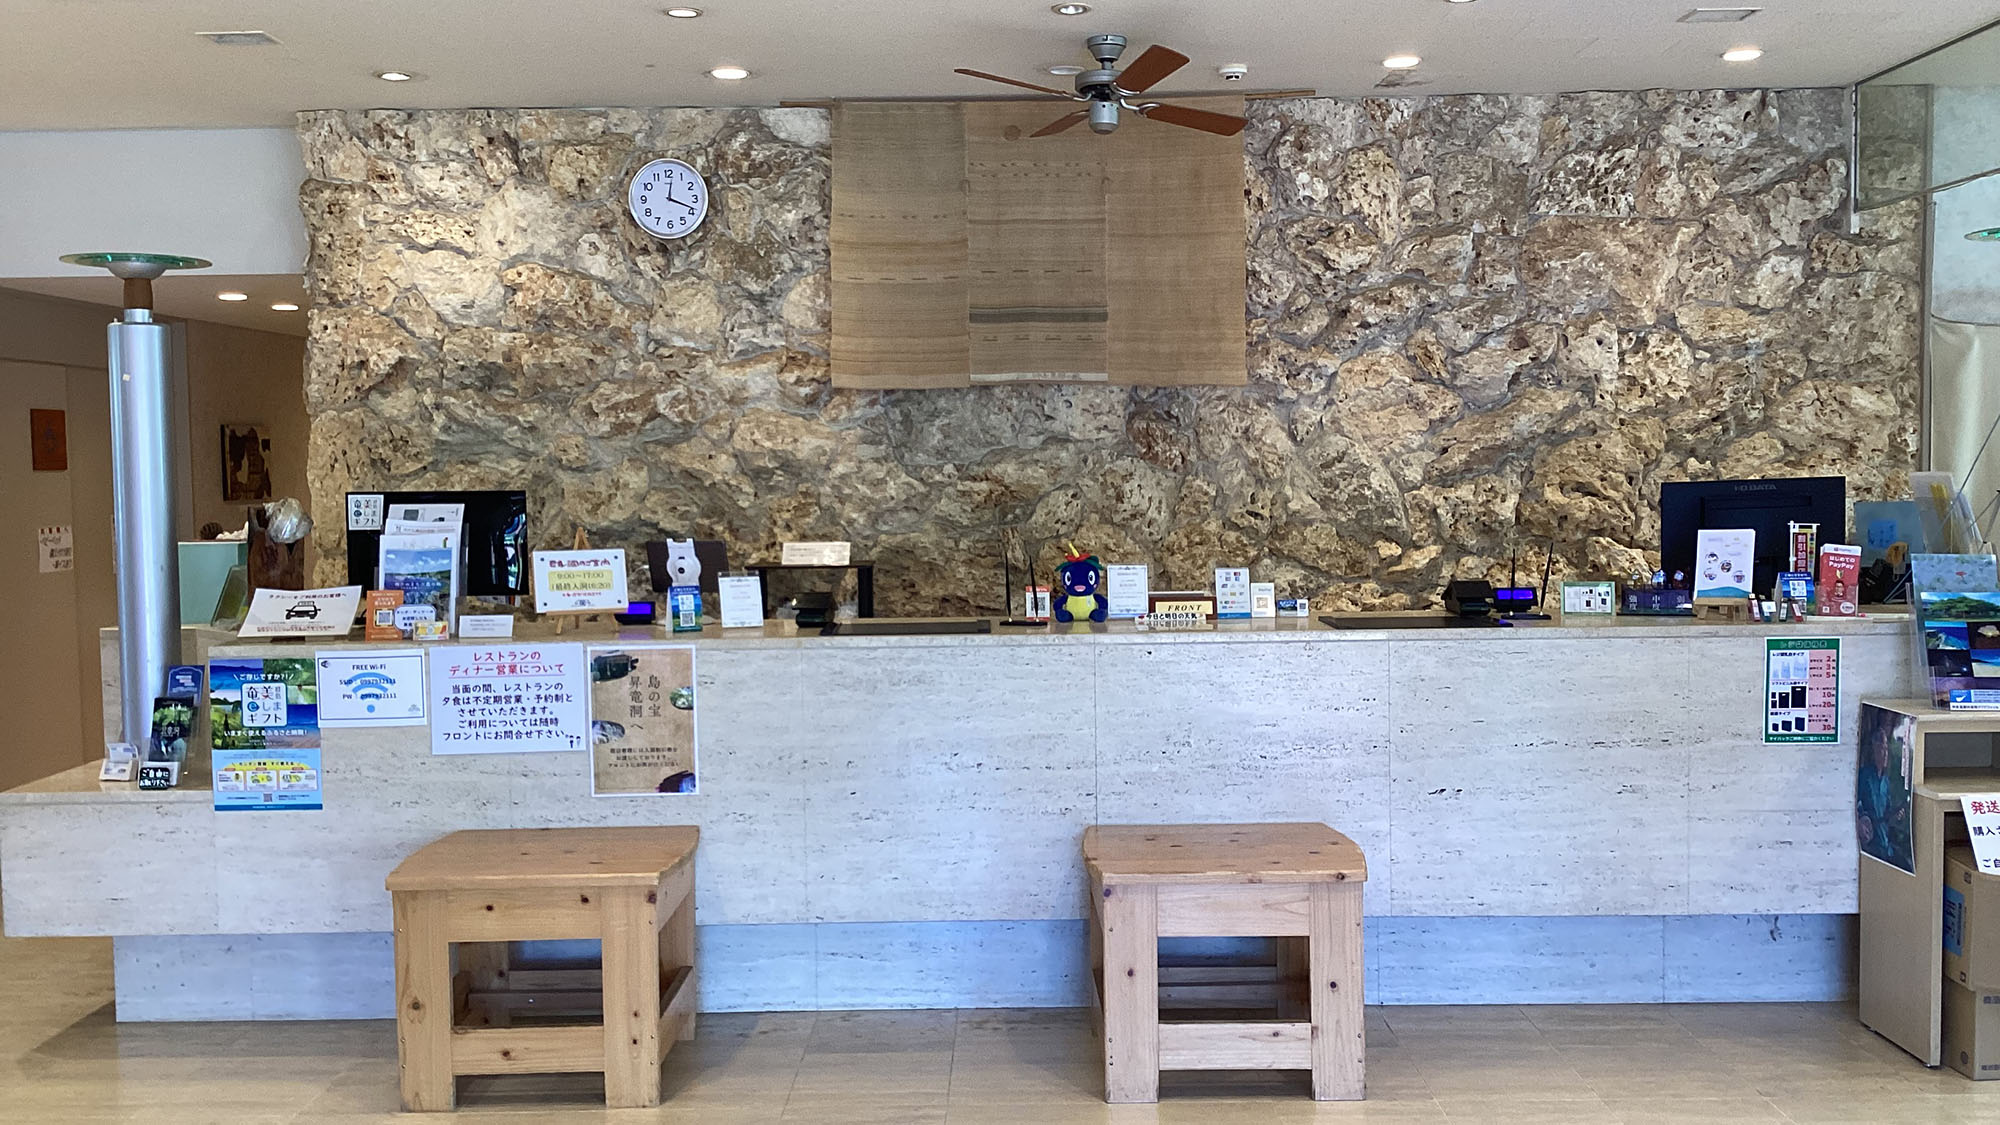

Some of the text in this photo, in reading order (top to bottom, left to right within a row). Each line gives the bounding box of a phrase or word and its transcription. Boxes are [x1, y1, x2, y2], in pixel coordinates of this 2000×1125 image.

[653, 173, 660, 182] 11
[664, 169, 673, 178] 12
[680, 173, 683, 181] 1
[643, 182, 653, 191] 10
[688, 182, 694, 190] 2
[640, 195, 647, 204] 9
[692, 195, 698, 203] 3
[645, 208, 652, 217] 8
[688, 207, 695, 216] 4
[654, 217, 661, 225] 7
[667, 220, 674, 229] 6
[680, 217, 686, 225] 5
[1828, 561, 1855, 570] PayPay
[1167, 604, 1203, 612] FRONT
[1146, 612, 1198, 620] 今日と明日の天気
[473, 651, 541, 662] レストランの
[449, 663, 565, 676] ディナー営業について
[452, 682, 564, 694] 当面の間、レストランの
[442, 693, 573, 706] 夕食は不定期営業・予約制と
[647, 674, 661, 718] 島の宝
[629, 675, 643, 730] 昇竜洞へ
[458, 706, 554, 717] させていただきます。
[247, 713, 282, 724] ギフト
[458, 717, 559, 729] ご利用については随時
[442, 729, 569, 742] フロントにお問合せ下さい。
[1971, 800, 2000, 815] 発送
